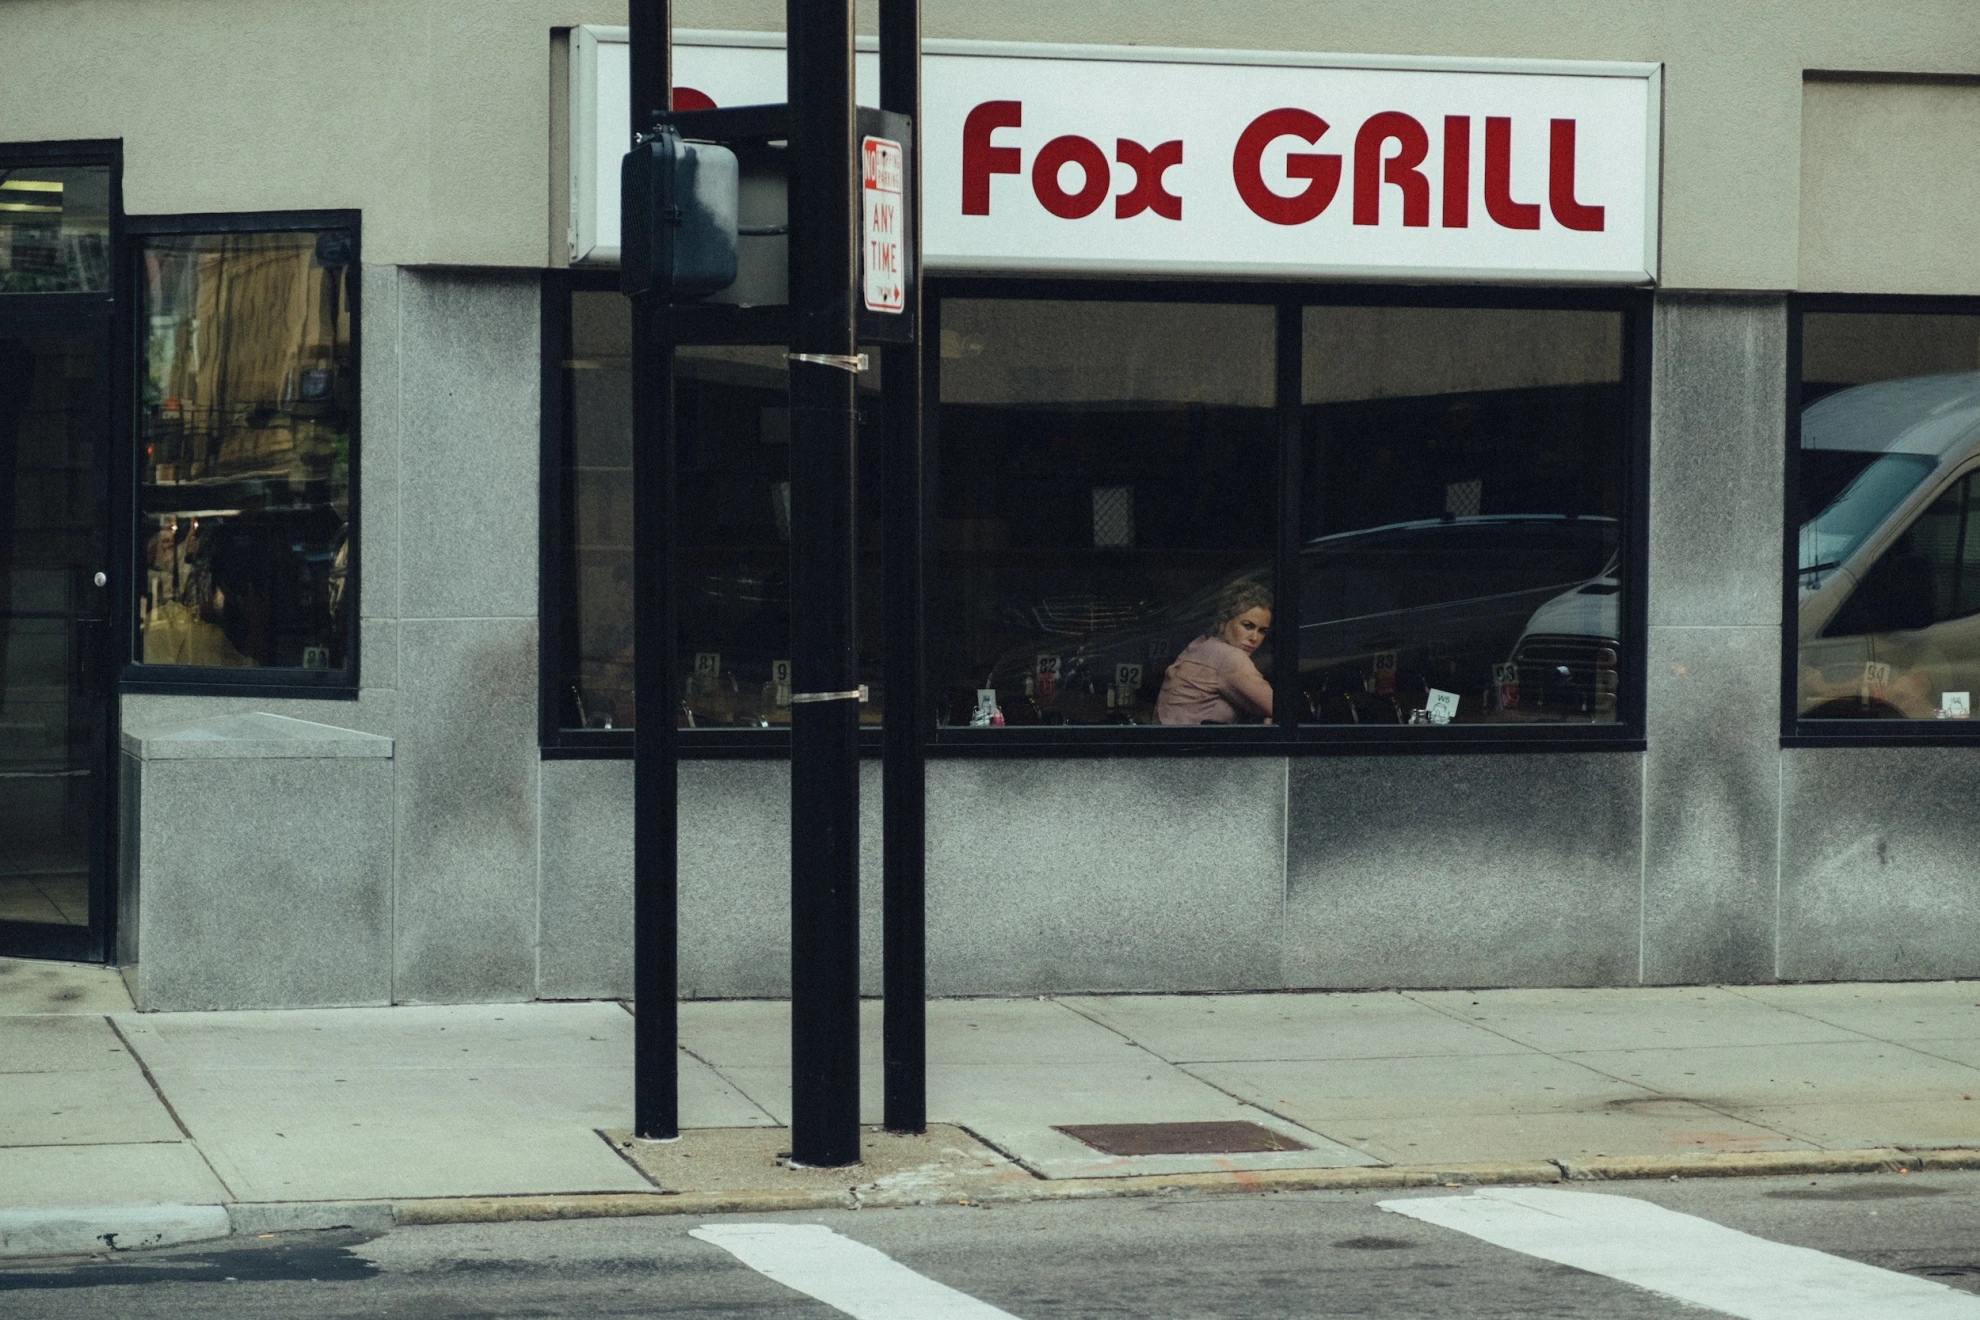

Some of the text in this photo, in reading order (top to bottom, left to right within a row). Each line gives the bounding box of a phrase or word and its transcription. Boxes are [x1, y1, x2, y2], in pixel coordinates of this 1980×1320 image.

[864, 150, 876, 181] NO
[962, 100, 1605, 232] Fox GRILL
[873, 203, 895, 234] ANY
[871, 241, 897, 273] TIME
[699, 655, 716, 673] 81
[1039, 657, 1057, 674] 82
[1376, 654, 1394, 669] 83
[1120, 667, 1139, 684] 92
[1437, 695, 1451, 704] W5
